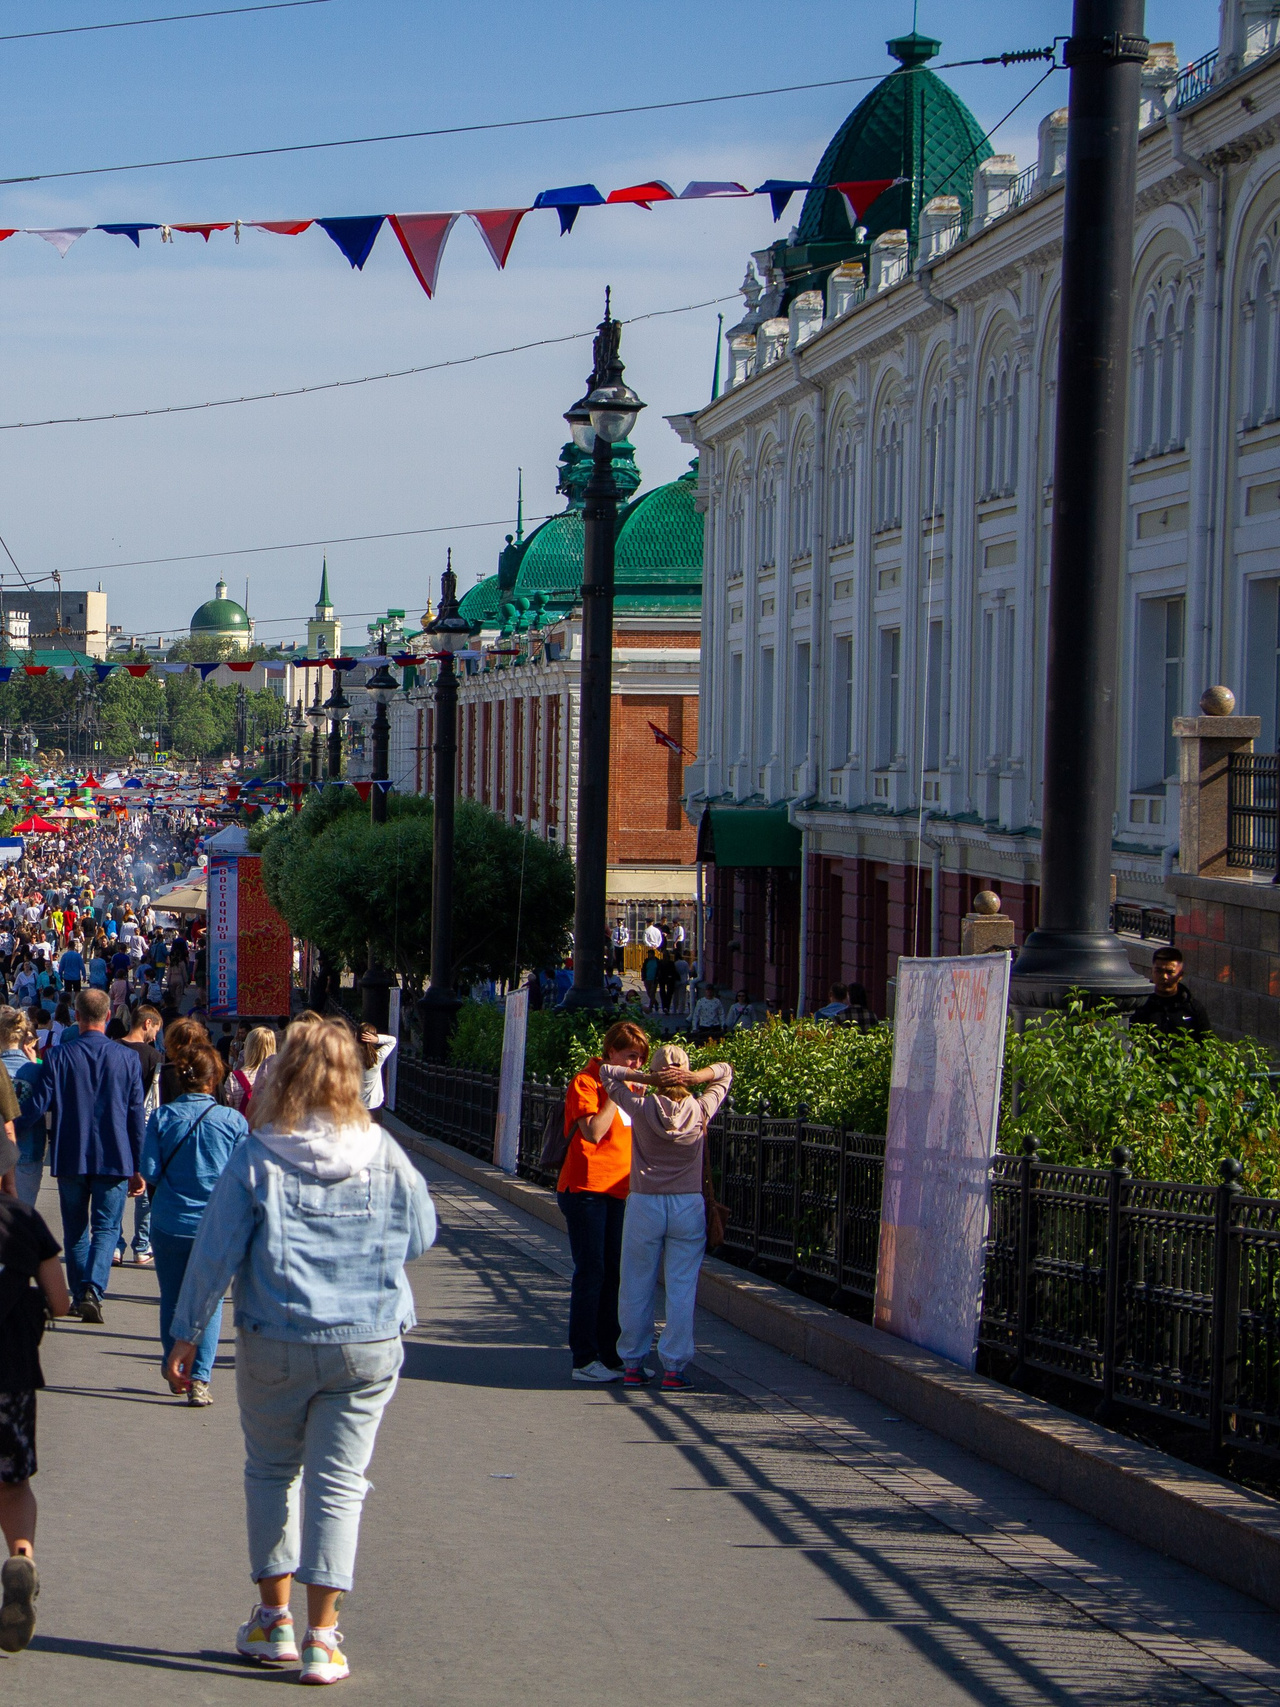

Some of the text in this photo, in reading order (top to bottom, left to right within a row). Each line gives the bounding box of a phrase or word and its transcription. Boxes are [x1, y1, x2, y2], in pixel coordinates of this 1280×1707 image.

[217, 868, 228, 1005] ВОСТОЧНЫЙ ГОРОДОК
[905, 969, 945, 1021] РОССИЯ
[948, 969, 971, 1021] ЭТО
